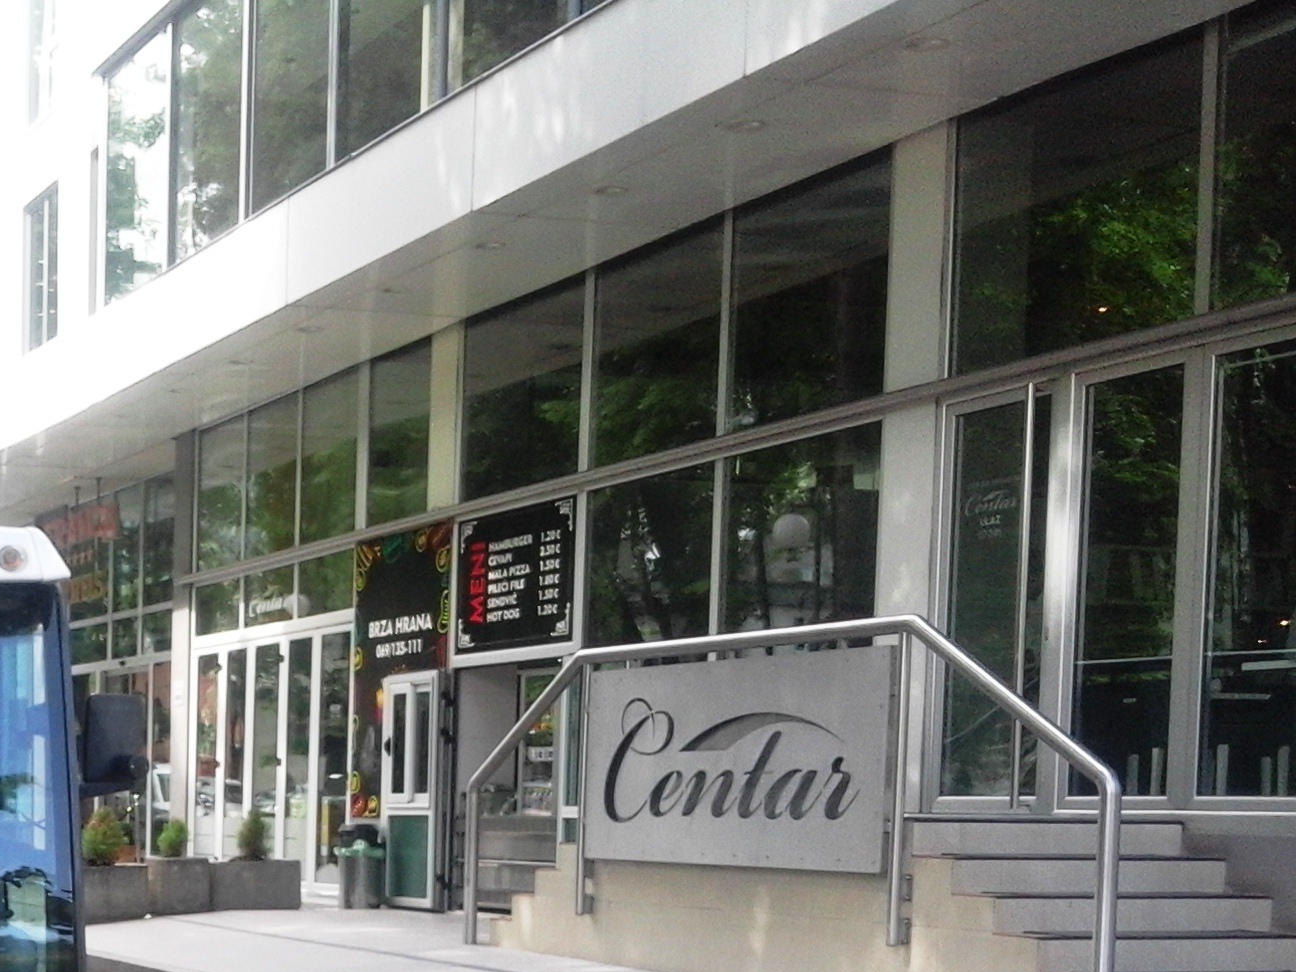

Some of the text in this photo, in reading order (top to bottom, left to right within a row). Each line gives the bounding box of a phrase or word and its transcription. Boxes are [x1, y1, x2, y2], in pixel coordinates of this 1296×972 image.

[509, 564, 531, 576] PIZZA
[486, 610, 503, 623] HOT
[503, 608, 520, 620] DOG
[368, 613, 433, 639] BRZA HRANA
[605, 697, 861, 823] Centar
